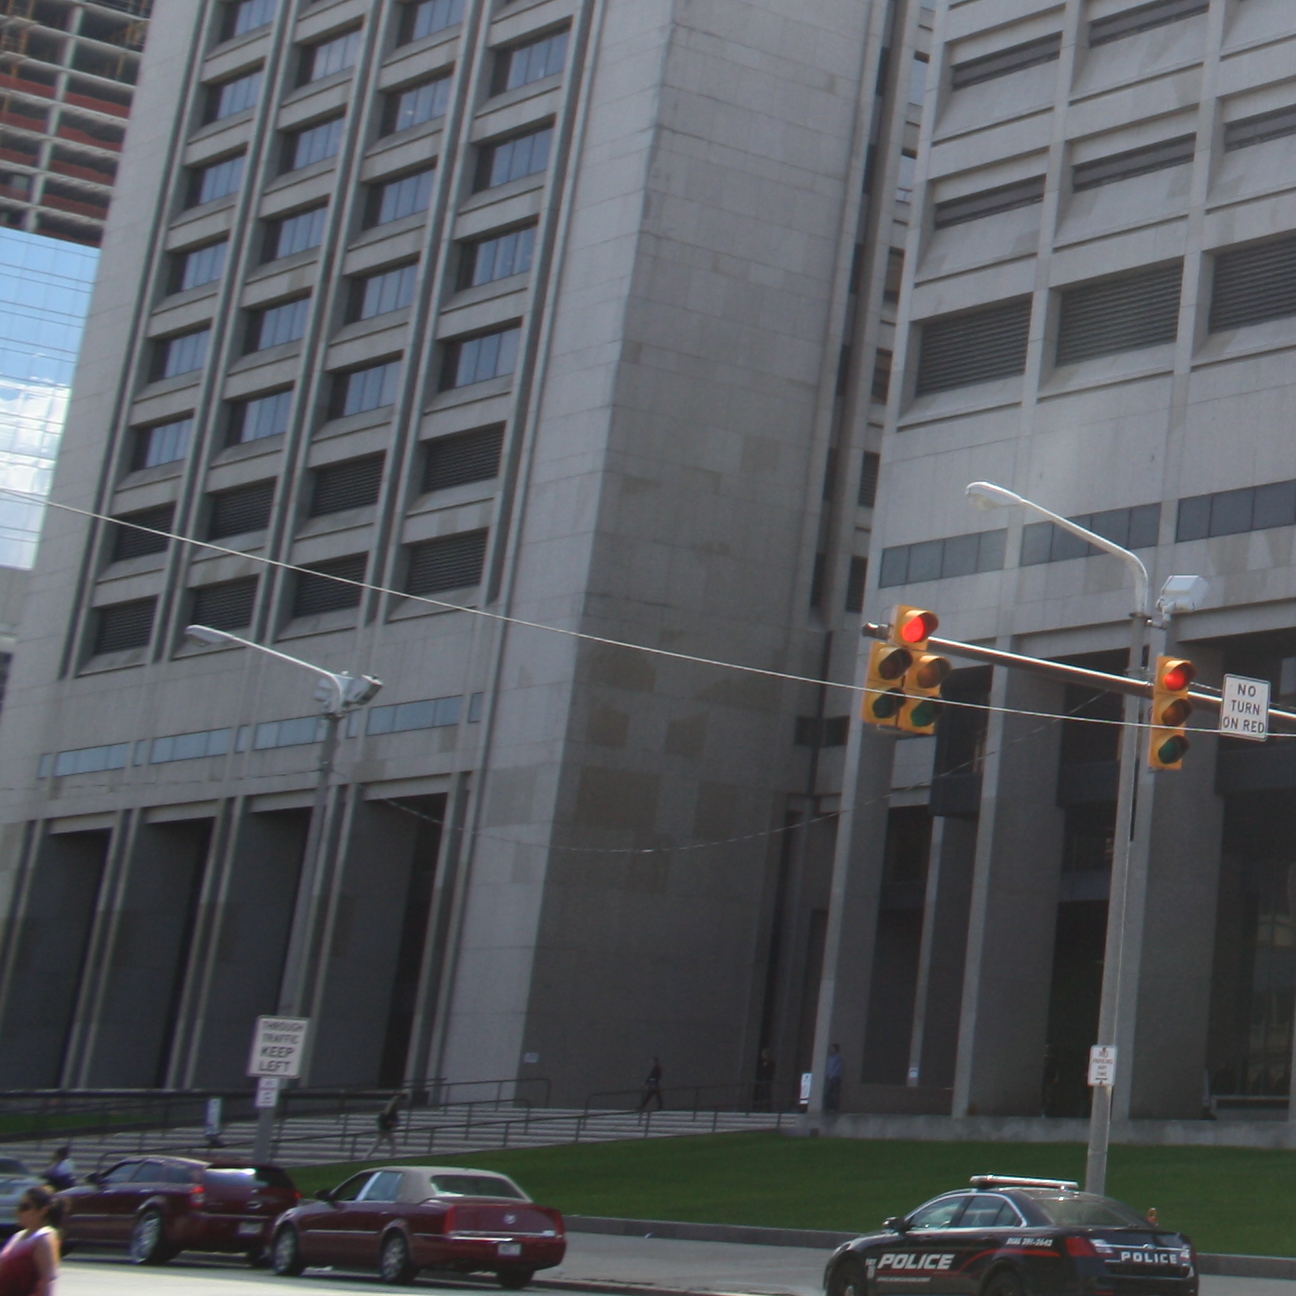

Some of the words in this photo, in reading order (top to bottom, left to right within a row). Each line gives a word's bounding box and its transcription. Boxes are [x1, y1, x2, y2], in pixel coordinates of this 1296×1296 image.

[1237, 684, 1256, 697] NO
[1231, 700, 1260, 715] TURN
[1222, 716, 1239, 730] ON
[1243, 719, 1265, 734] RED
[261, 1033, 300, 1044] TRAFFIC
[260, 1046, 295, 1058] KEEP
[258, 1060, 291, 1072] LEFT
[877, 1253, 956, 1270] POLICE
[1120, 1251, 1178, 1264] POLICE
